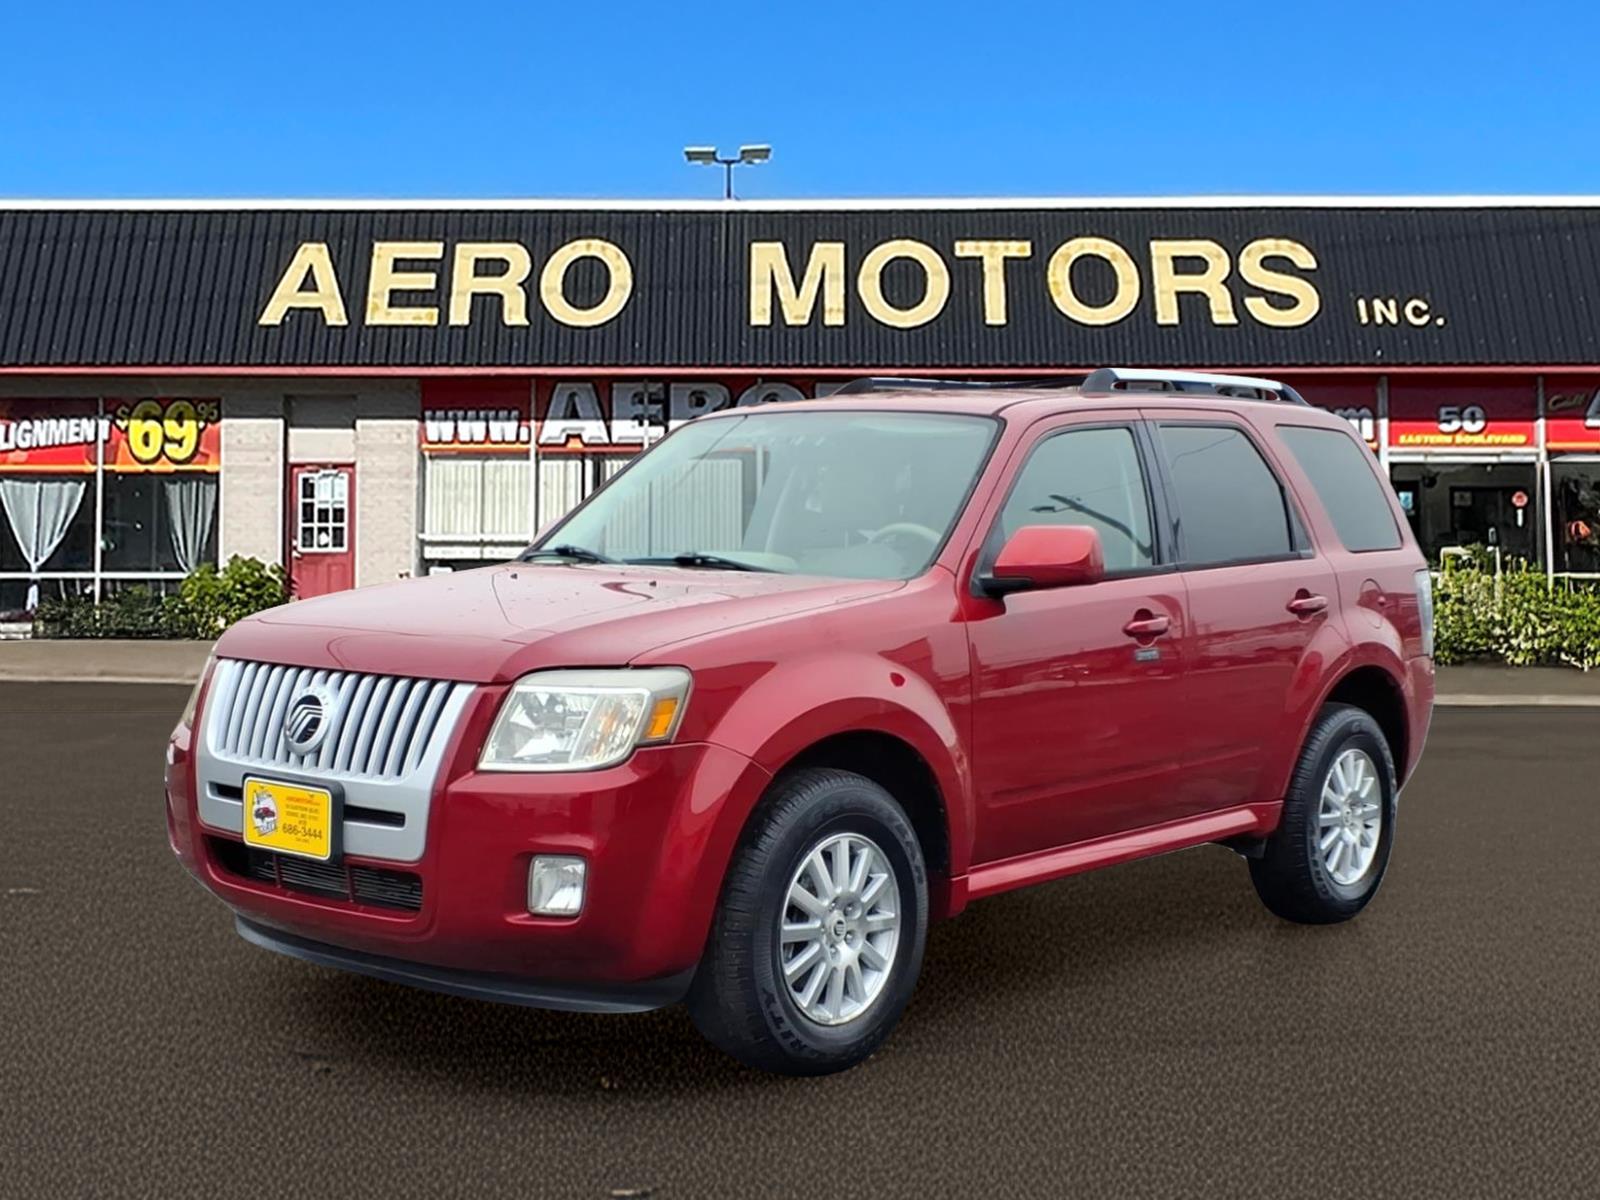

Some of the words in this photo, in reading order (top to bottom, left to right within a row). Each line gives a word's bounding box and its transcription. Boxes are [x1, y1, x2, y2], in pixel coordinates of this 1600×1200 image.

[257, 238, 633, 328] AERO
[749, 236, 1320, 329] MOTORS
[1357, 298, 1446, 327] INC.
[1437, 405, 1486, 433] 50
[1399, 434, 1453, 445] EASTERN
[1455, 434, 1527, 445] BOULEVARD
[282, 823, 322, 840] 686-3444
